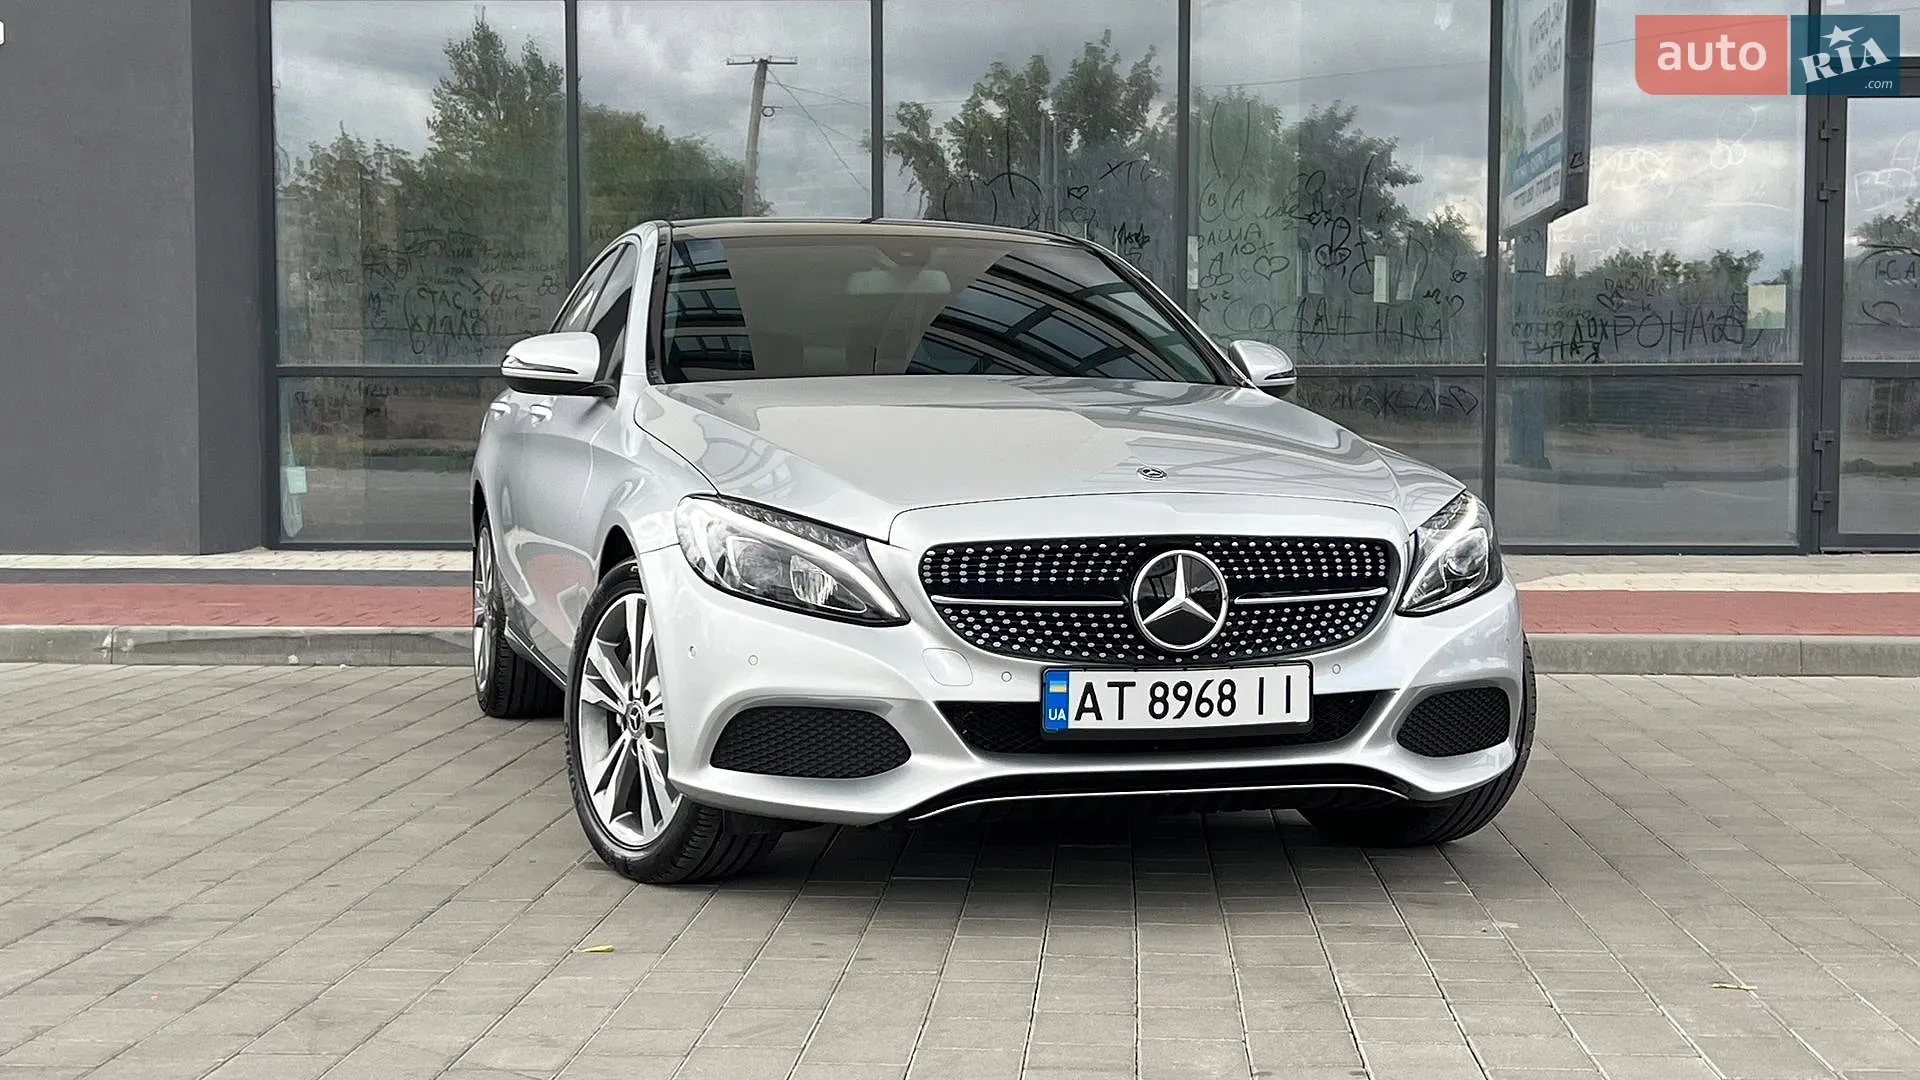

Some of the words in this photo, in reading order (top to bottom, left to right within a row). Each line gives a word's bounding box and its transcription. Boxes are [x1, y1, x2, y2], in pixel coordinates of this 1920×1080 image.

[1074, 681, 1137, 721] AT
[1148, 678, 1237, 720] 8968
[1048, 708, 1067, 721] UA
